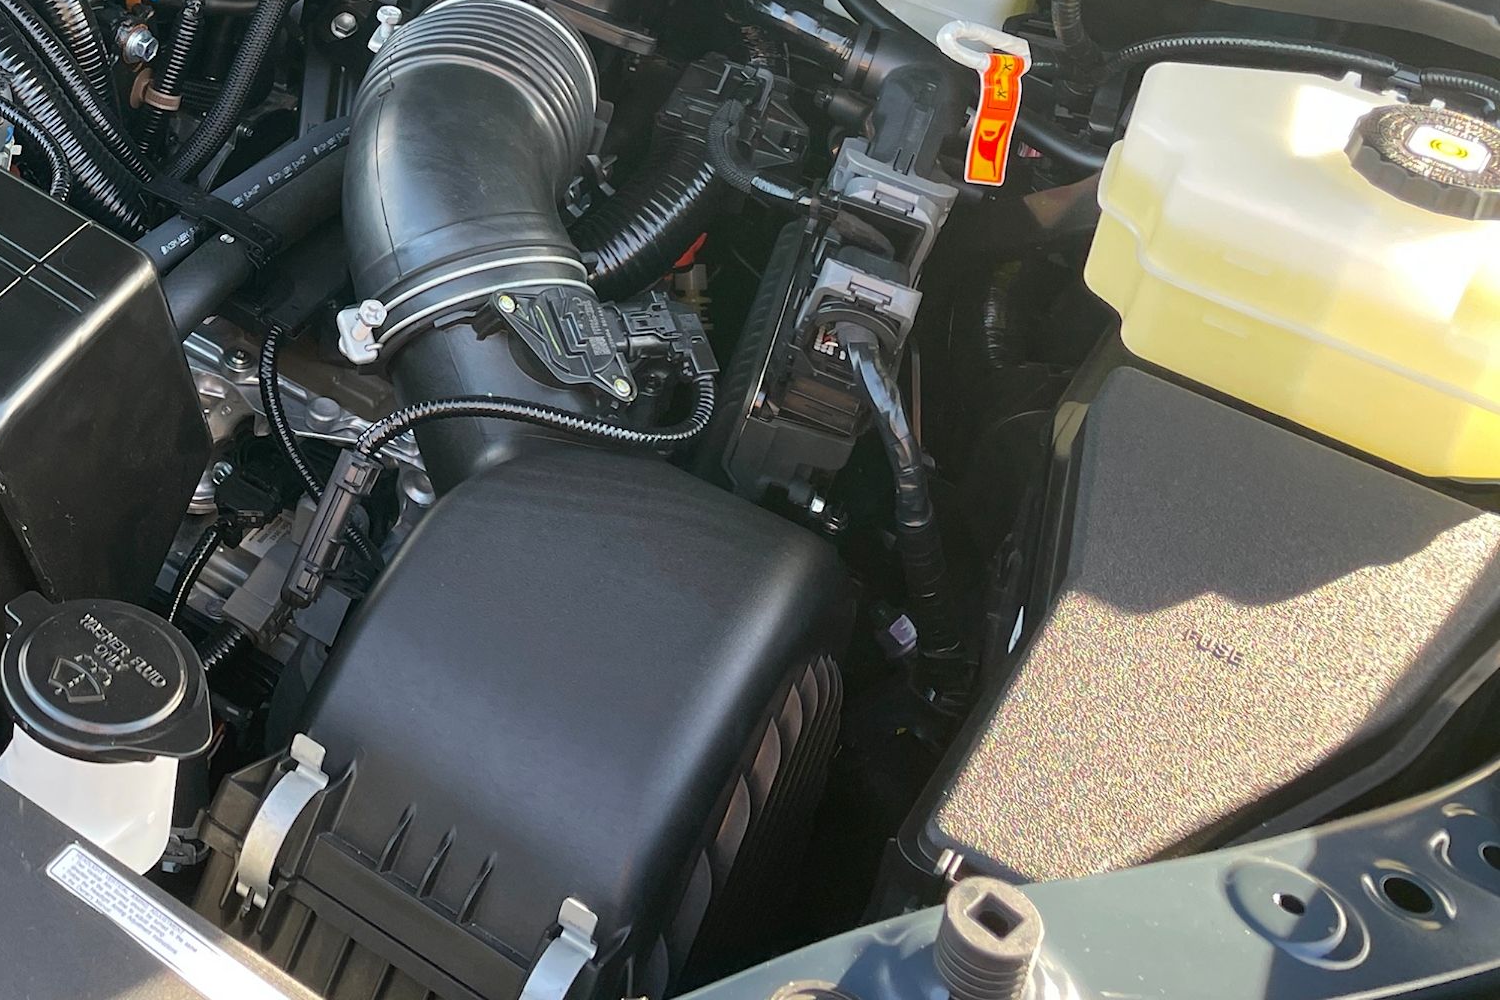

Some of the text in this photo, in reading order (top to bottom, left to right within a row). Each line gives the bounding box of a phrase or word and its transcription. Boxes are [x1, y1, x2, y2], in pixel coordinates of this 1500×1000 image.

[80, 613, 167, 688] WASHER FLUID
[93, 643, 130, 672] ONLY
[1183, 629, 1245, 667] FUSE
